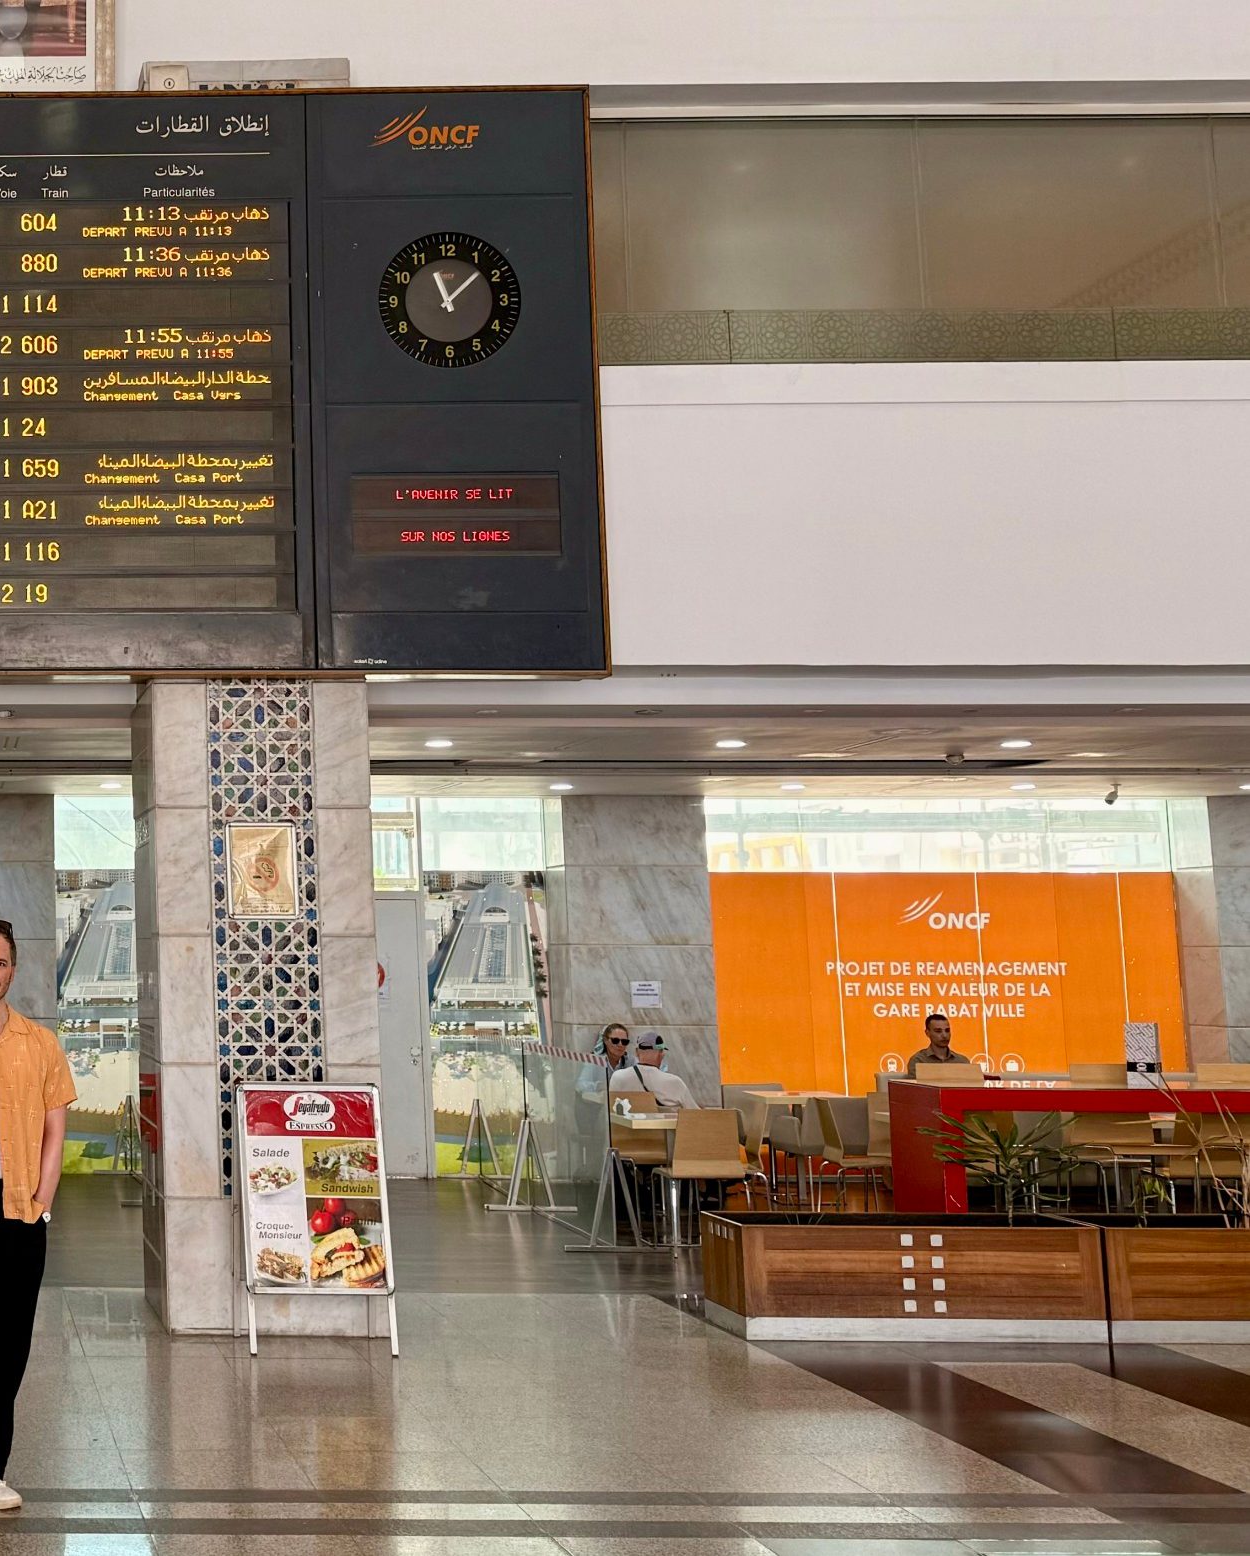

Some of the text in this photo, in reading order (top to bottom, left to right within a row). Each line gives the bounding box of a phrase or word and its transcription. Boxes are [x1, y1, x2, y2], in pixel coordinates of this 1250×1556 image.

[135, 114, 270, 138] إنطلاق القطارات
[406, 124, 481, 144] ONCF
[42, 164, 68, 181] قطار
[154, 163, 204, 177] ملاحظات
[41, 187, 69, 198] Train
[143, 186, 216, 198] Particularités
[20, 212, 57, 232] 604
[122, 206, 270, 225] ذهاب مرتقب 11:13
[82, 225, 232, 238] DEPART PREVU A 11:13
[123, 246, 181, 262] 11:36
[438, 243, 456, 257] 12
[21, 253, 58, 273] 880
[411, 252, 426, 265] 11
[471, 251, 479, 264] 1
[82, 266, 233, 279] DEPART PREVU A 11:36
[394, 271, 412, 287] 10
[491, 269, 501, 282] 2
[2, 294, 58, 314] 1 114
[388, 295, 399, 308] 9
[499, 293, 509, 307] 3
[398, 320, 408, 334] 8
[490, 319, 501, 332] 4
[124, 327, 183, 344] 11:55
[0, 335, 58, 354] 2 606
[418, 339, 428, 352] 7
[445, 345, 455, 358] 6
[472, 338, 482, 351] 5
[83, 348, 234, 360] DEPART PREVU A 11:55
[2, 376, 58, 396] 1 903
[173, 390, 204, 401] Casa
[2, 417, 46, 437] 1 24
[3, 458, 59, 478] 1 659
[174, 472, 244, 483] Casa Port
[395, 488, 513, 500] L'AVENIR SE LIT
[3, 499, 57, 520] 1 A21
[175, 513, 245, 525] Casa Port
[400, 530, 510, 542] SUR NOS LIGNES
[4, 541, 60, 562] 1 116
[1, 583, 48, 603] 2 19
[928, 912, 991, 930] ONCF
[826, 962, 1068, 976] PROJET DE REAMENAGEMENT
[845, 982, 1052, 997] ET MISE EN VALEUR DE LA
[873, 1003, 1025, 1018] GARE RABAT VILLE
[252, 1148, 290, 1158] Salade
[321, 1183, 374, 1194] Sandwish
[255, 1221, 293, 1234] Croque-
[258, 1230, 303, 1240] Monsieur
